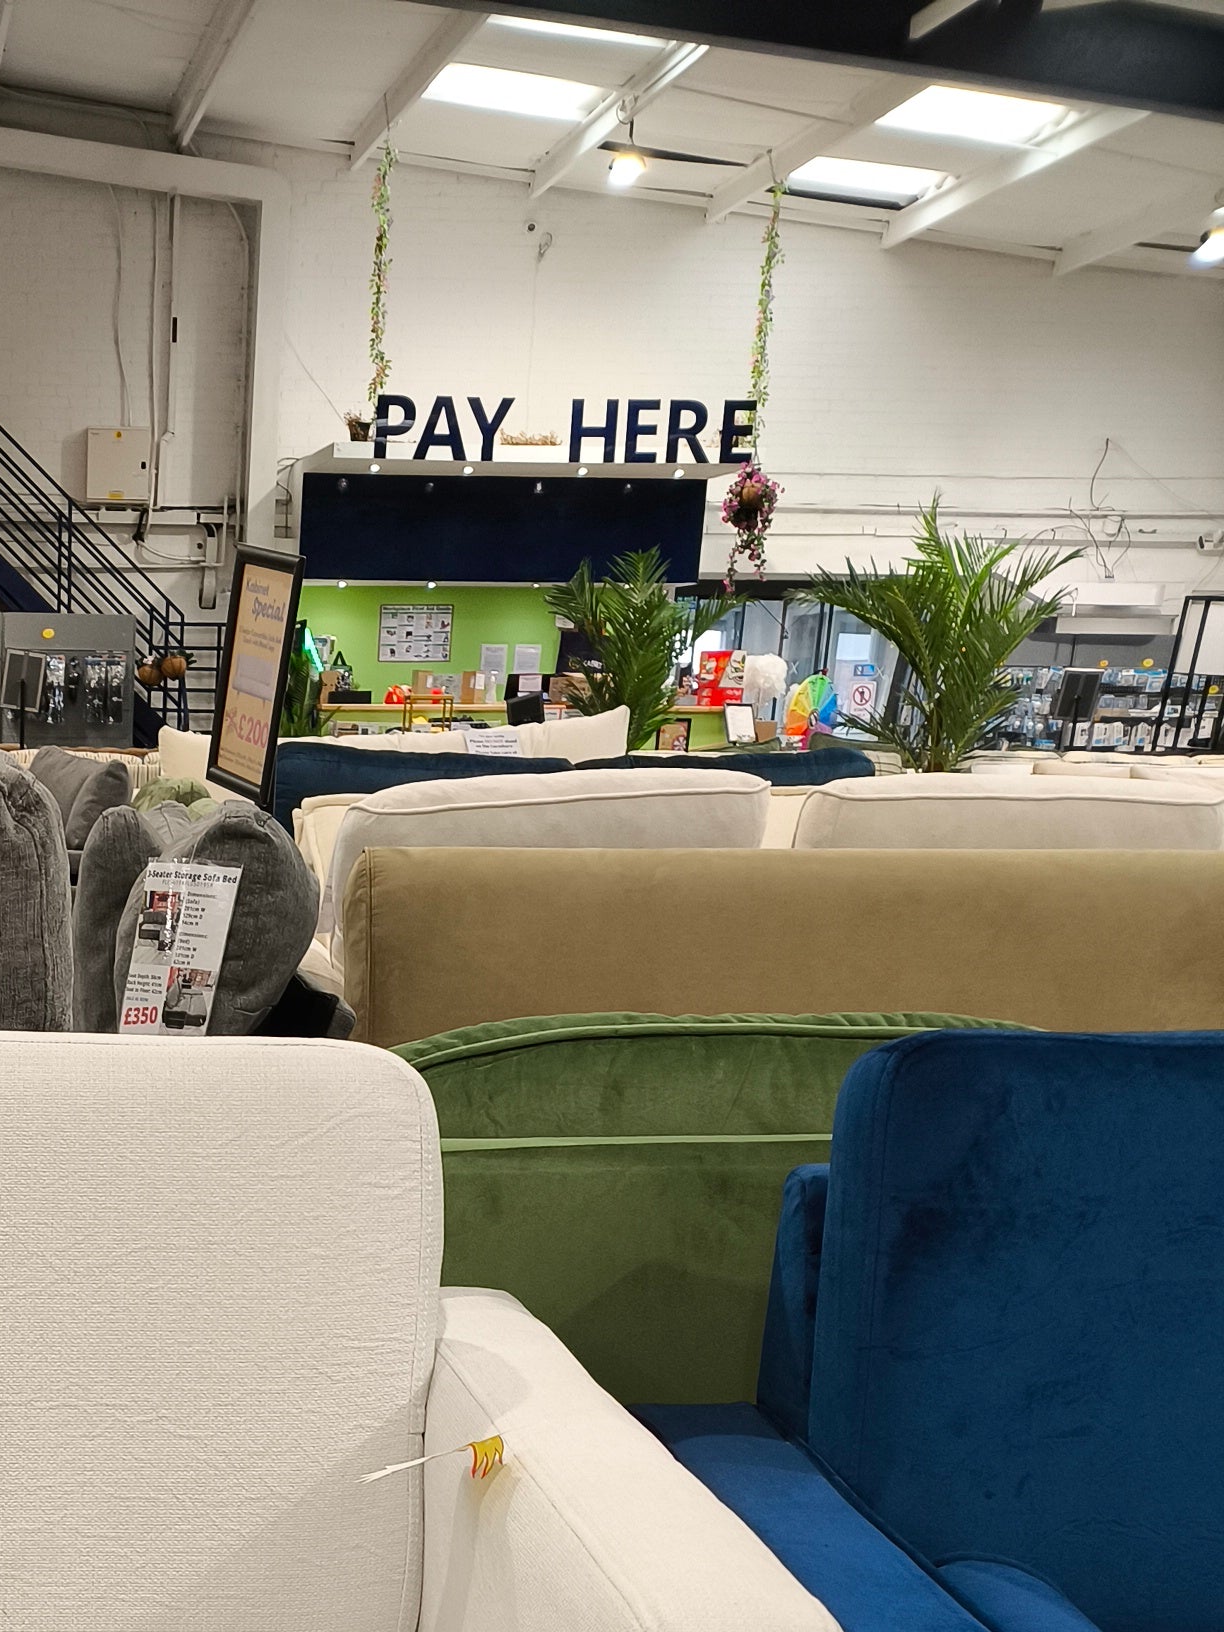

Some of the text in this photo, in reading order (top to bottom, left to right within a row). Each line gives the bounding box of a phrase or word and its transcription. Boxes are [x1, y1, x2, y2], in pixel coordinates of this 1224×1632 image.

[374, 394, 758, 465] PAY HERE
[236, 713, 269, 749] £200
[174, 870, 202, 883] Storage
[203, 873, 221, 883] Sofa
[222, 875, 238, 884] Bed
[123, 1005, 159, 1025] £350
